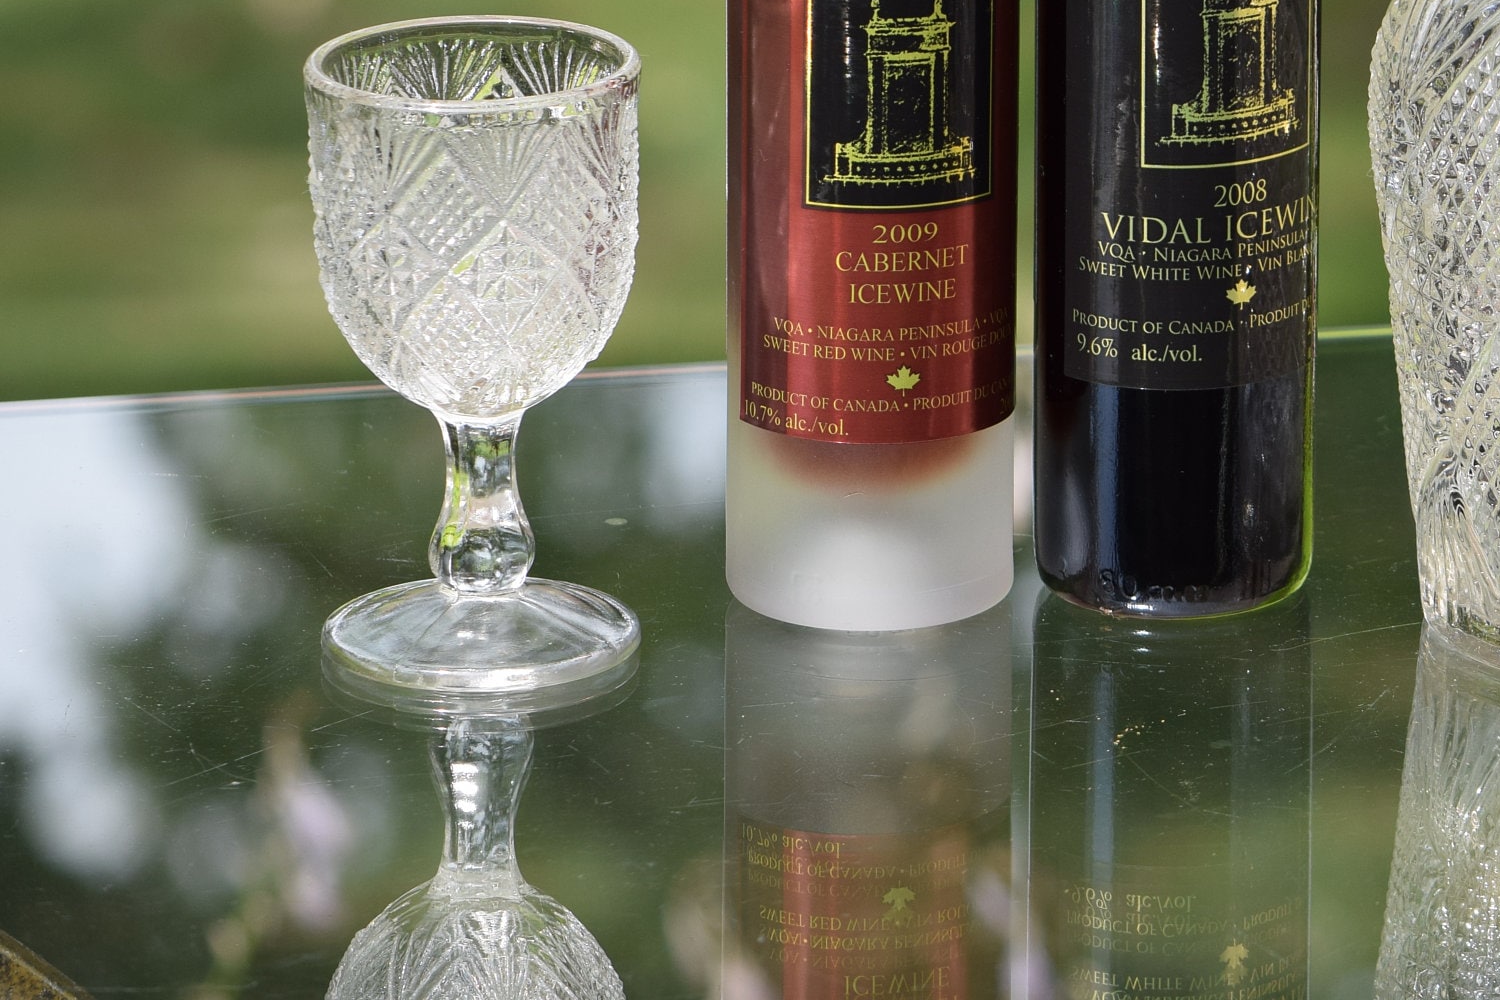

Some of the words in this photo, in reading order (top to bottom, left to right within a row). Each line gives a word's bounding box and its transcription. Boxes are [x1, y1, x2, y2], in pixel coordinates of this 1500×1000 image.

[1214, 178, 1267, 208] 2008
[872, 222, 938, 244] 2009
[1100, 212, 1211, 244] VIDAL
[1226, 194, 1318, 241] ICEWIN
[835, 244, 969, 273] CABERNET
[1098, 241, 1136, 263] VQA
[1154, 247, 1232, 262] NIAGARA
[1079, 256, 1127, 278] SWEET
[1132, 265, 1190, 281] WHITE
[1196, 264, 1242, 280] WINE
[1258, 257, 1281, 273] VIN
[848, 278, 957, 304] ICEWINE
[774, 317, 804, 337] VQA
[817, 325, 895, 342] NIAGARA
[899, 316, 981, 341] PENINSULA
[1072, 308, 1138, 332] PRODUCT
[1142, 320, 1163, 334] OF
[1168, 320, 1234, 335] CANADA
[1250, 302, 1300, 328] PRODUIT
[763, 334, 808, 356] SWEET
[813, 345, 846, 360] RED
[852, 348, 895, 361] WINE
[911, 345, 938, 360] VIN
[942, 334, 988, 356] ROUGE
[1077, 333, 1118, 358] 9.6%
[1131, 344, 1203, 362] alc./vol.
[751, 381, 808, 408] PRODUCT
[810, 396, 829, 410] OF
[833, 398, 900, 412] CANADA
[913, 390, 972, 411] PRODUIT
[744, 399, 781, 427] 10.7%
[785, 412, 849, 436] alc./vol.
